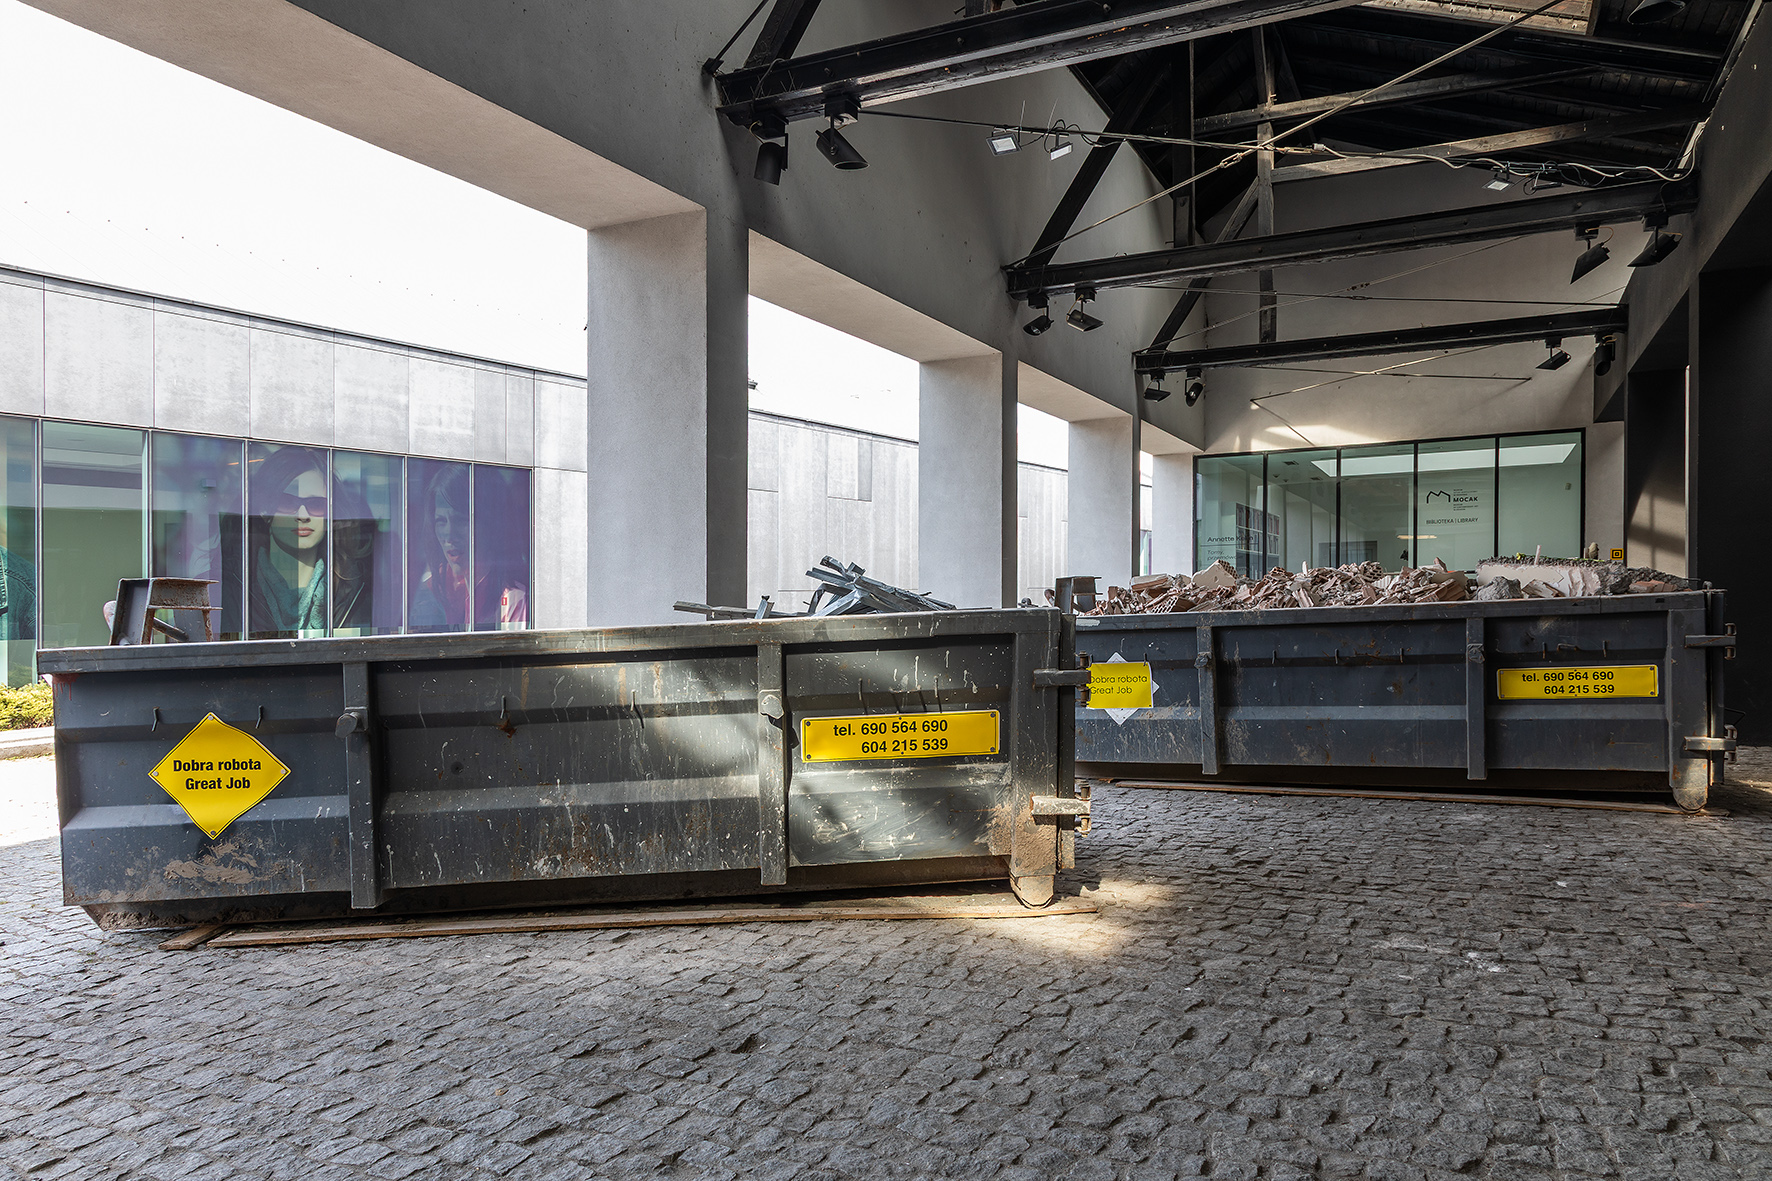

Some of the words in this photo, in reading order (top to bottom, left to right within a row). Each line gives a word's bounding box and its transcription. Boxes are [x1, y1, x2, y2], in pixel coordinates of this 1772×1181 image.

[1091, 675, 1116, 684] Dobra
[1117, 674, 1147, 683] robota
[1522, 673, 1540, 682] tel.
[1543, 672, 1565, 682] 690
[1567, 671, 1589, 681] 564
[1592, 671, 1614, 680] 690
[1090, 686, 1114, 694] Great
[1116, 686, 1133, 694] Job
[1544, 685, 1565, 695] 604
[1568, 684, 1590, 694] 215
[1593, 684, 1615, 693] 539
[833, 724, 856, 736] tel.
[861, 722, 887, 735] 690
[891, 721, 918, 733] 564
[921, 719, 948, 732] 690
[861, 740, 887, 754] 604
[892, 739, 918, 752] 215
[922, 738, 948, 751] 539
[173, 759, 214, 772] Dobra
[218, 758, 261, 771] robota
[185, 777, 222, 790] Great
[226, 776, 251, 789] Job
